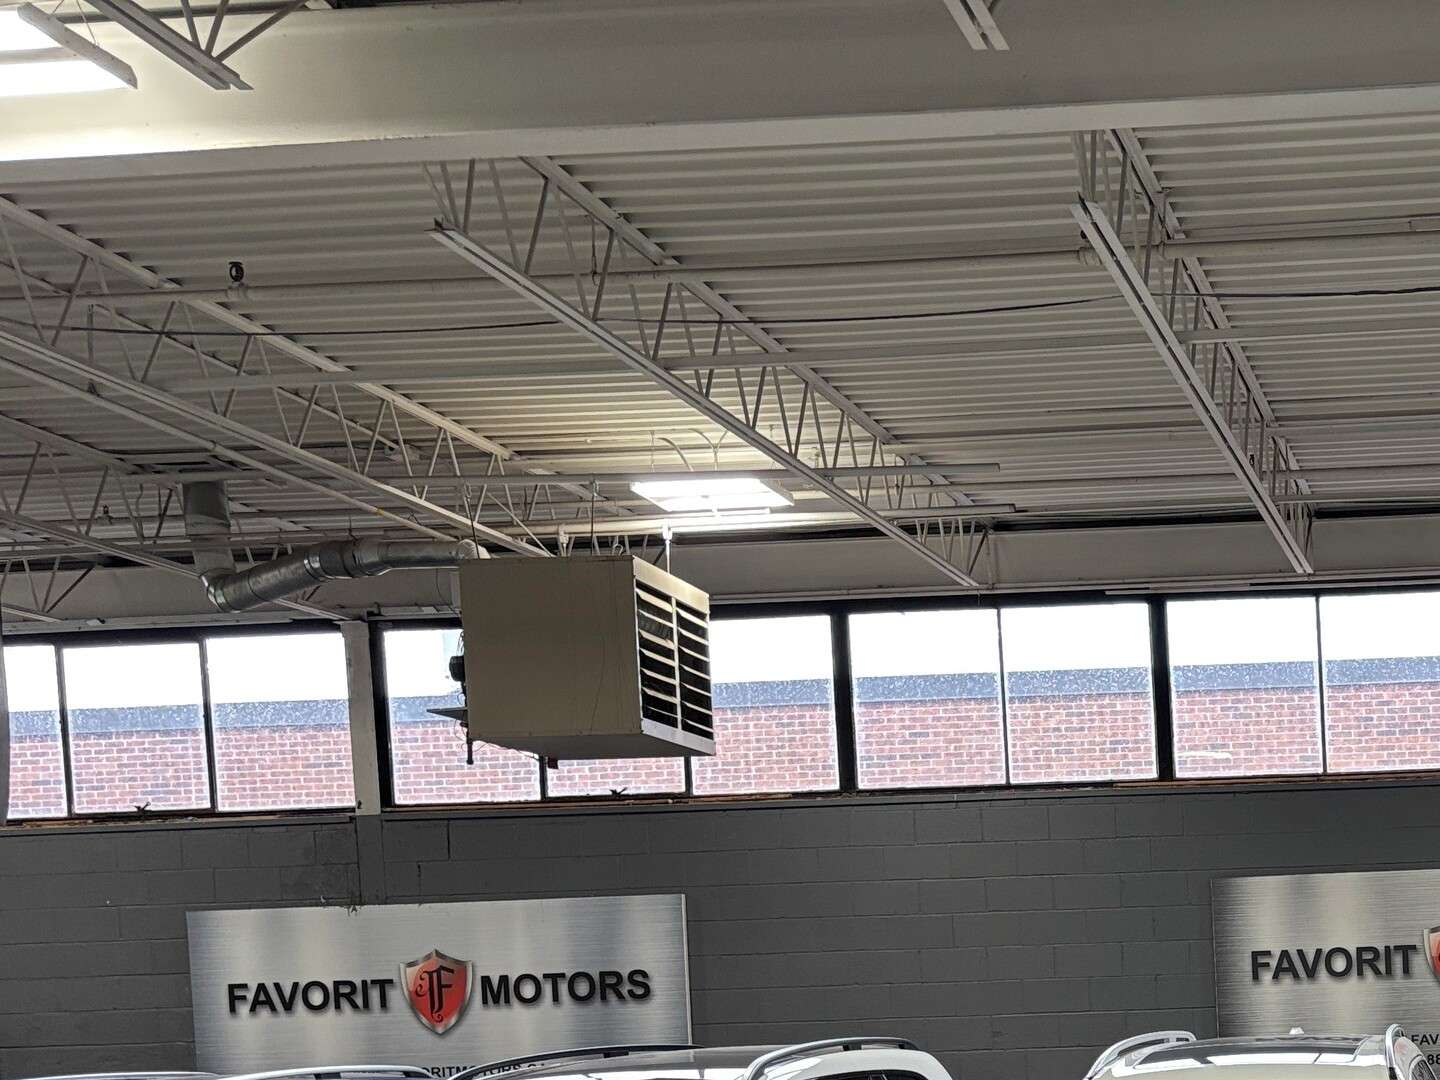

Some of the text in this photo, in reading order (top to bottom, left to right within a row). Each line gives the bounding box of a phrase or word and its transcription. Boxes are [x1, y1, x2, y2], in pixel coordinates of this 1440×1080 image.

[1250, 944, 1417, 982] FAVORIT
[227, 979, 394, 1015] FAVORIT
[480, 969, 652, 1009] MOTORS
